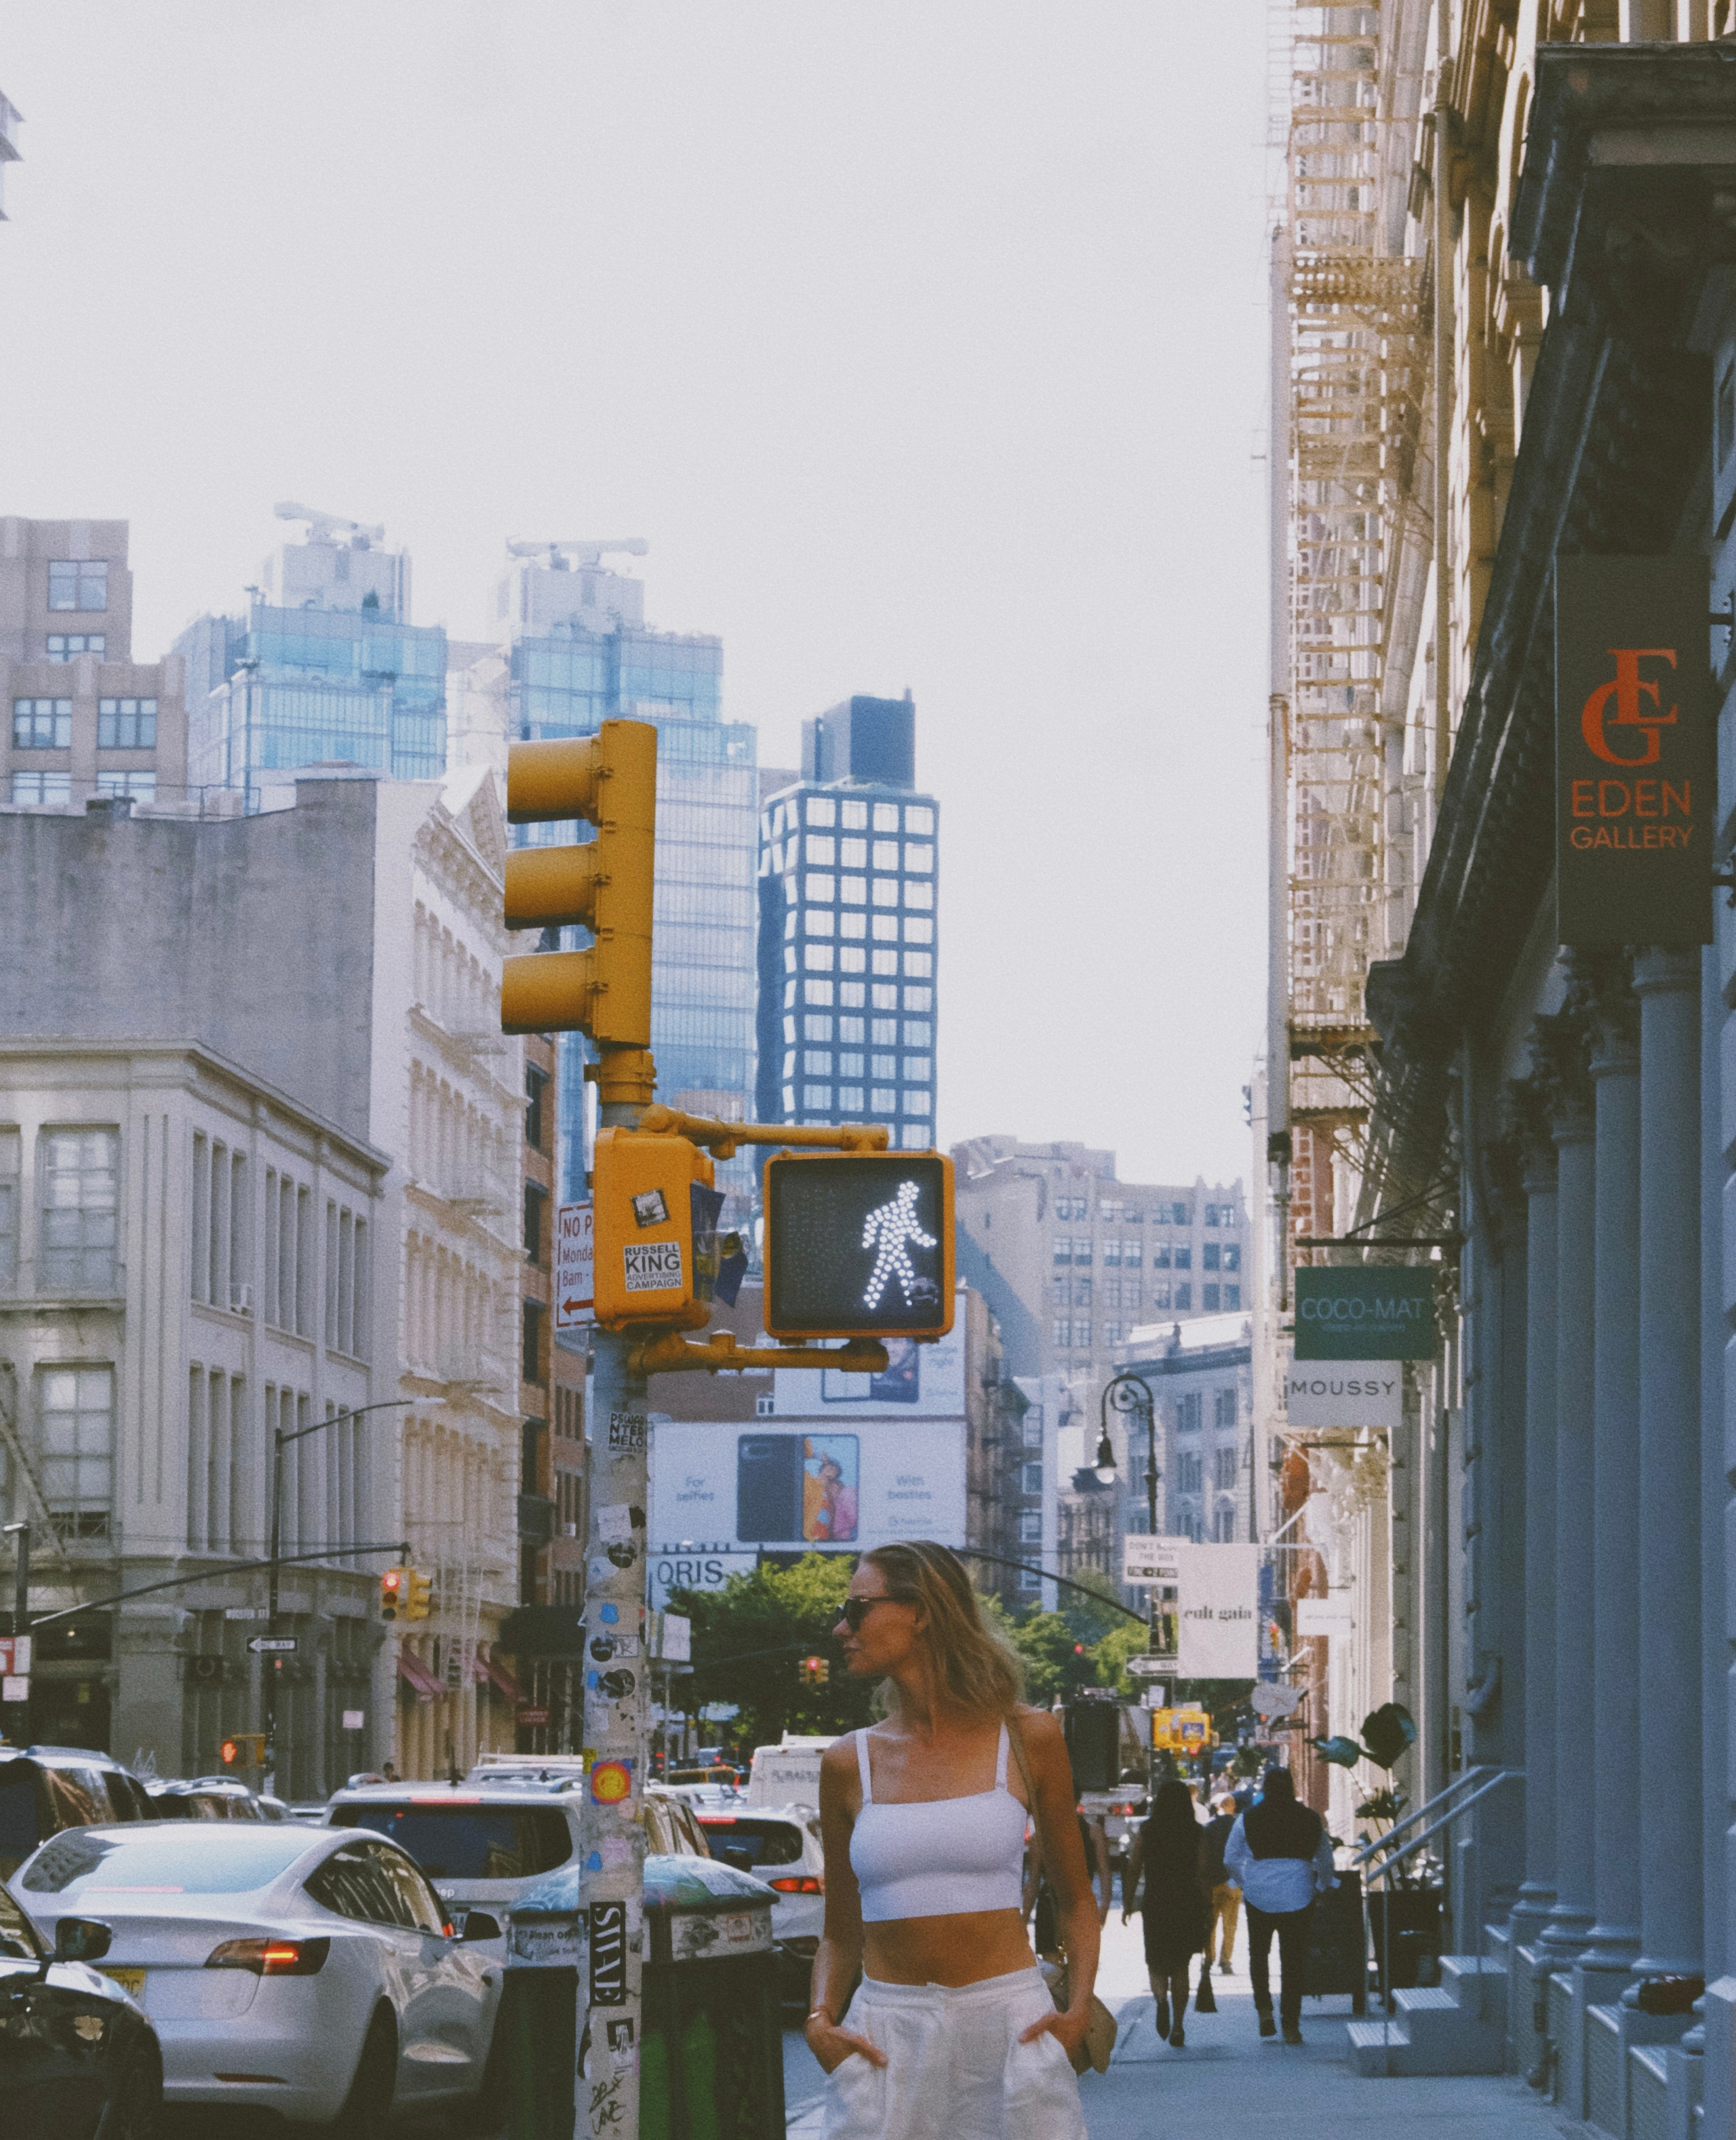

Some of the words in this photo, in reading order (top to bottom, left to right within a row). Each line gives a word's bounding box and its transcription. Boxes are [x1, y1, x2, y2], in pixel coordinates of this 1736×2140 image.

[1571, 780, 1691, 817] EDEN
[1570, 825, 1693, 850] GALLERY
[564, 1217, 580, 1239] NO
[585, 1214, 593, 1236] P
[625, 1244, 679, 1256] RUSSELL
[625, 1253, 681, 1274] KING
[562, 1270, 583, 1287] 8am
[626, 1270, 682, 1282] ADVERTISING
[626, 1279, 682, 1290] CAMPAIGN
[1301, 1298, 1425, 1320] COCO-MAT
[1290, 1381, 1396, 1395] MOUSSY
[686, 1475, 705, 1488] For
[1183, 1606, 1213, 1620] cult
[1219, 1606, 1252, 1621] gaia
[594, 1906, 622, 2001] SWAE
